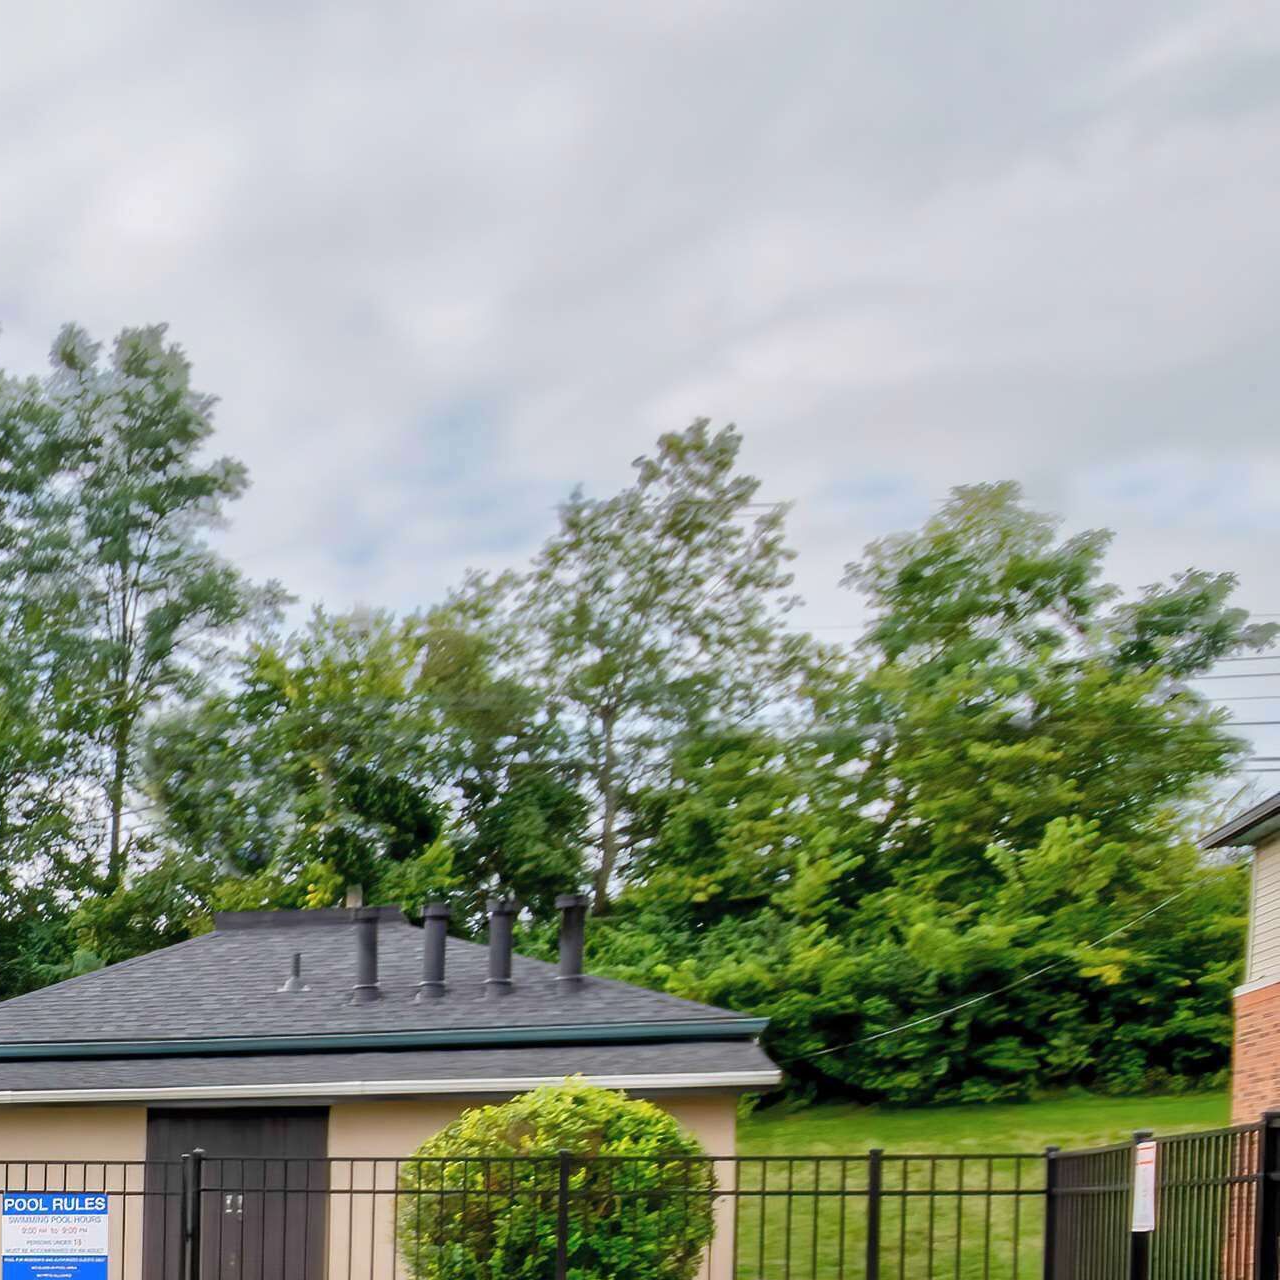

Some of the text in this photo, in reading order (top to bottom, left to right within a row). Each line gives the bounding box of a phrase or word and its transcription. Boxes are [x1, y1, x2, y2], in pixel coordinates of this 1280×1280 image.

[4, 1197, 106, 1211] POOL RULES
[8, 1216, 102, 1224] SWIMMING POOL HOURS
